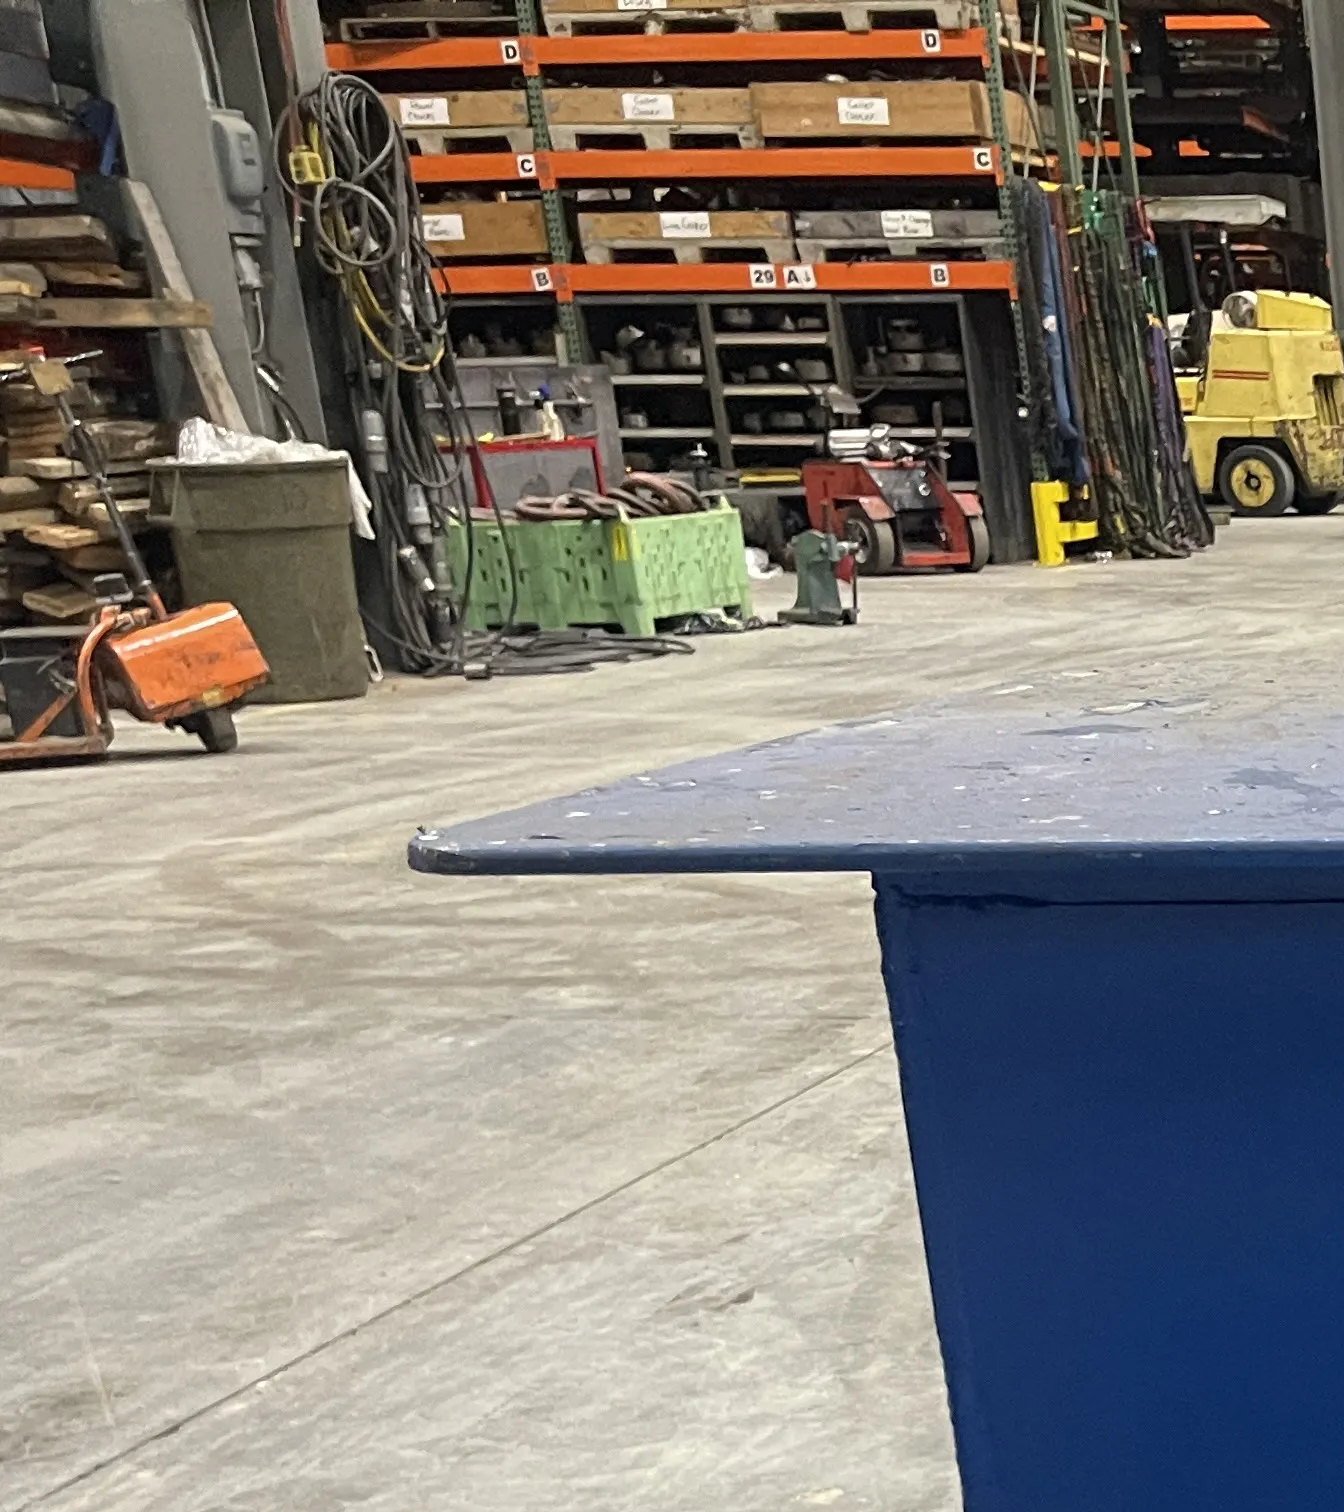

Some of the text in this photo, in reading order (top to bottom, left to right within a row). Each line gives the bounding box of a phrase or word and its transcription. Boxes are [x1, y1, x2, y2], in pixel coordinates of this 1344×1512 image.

[923, 33, 937, 48] D
[504, 44, 517, 60] D
[520, 158, 533, 173] C
[976, 151, 990, 167] C
[536, 272, 549, 287] B
[754, 269, 800, 284] 29 A
[933, 268, 947, 283] B
